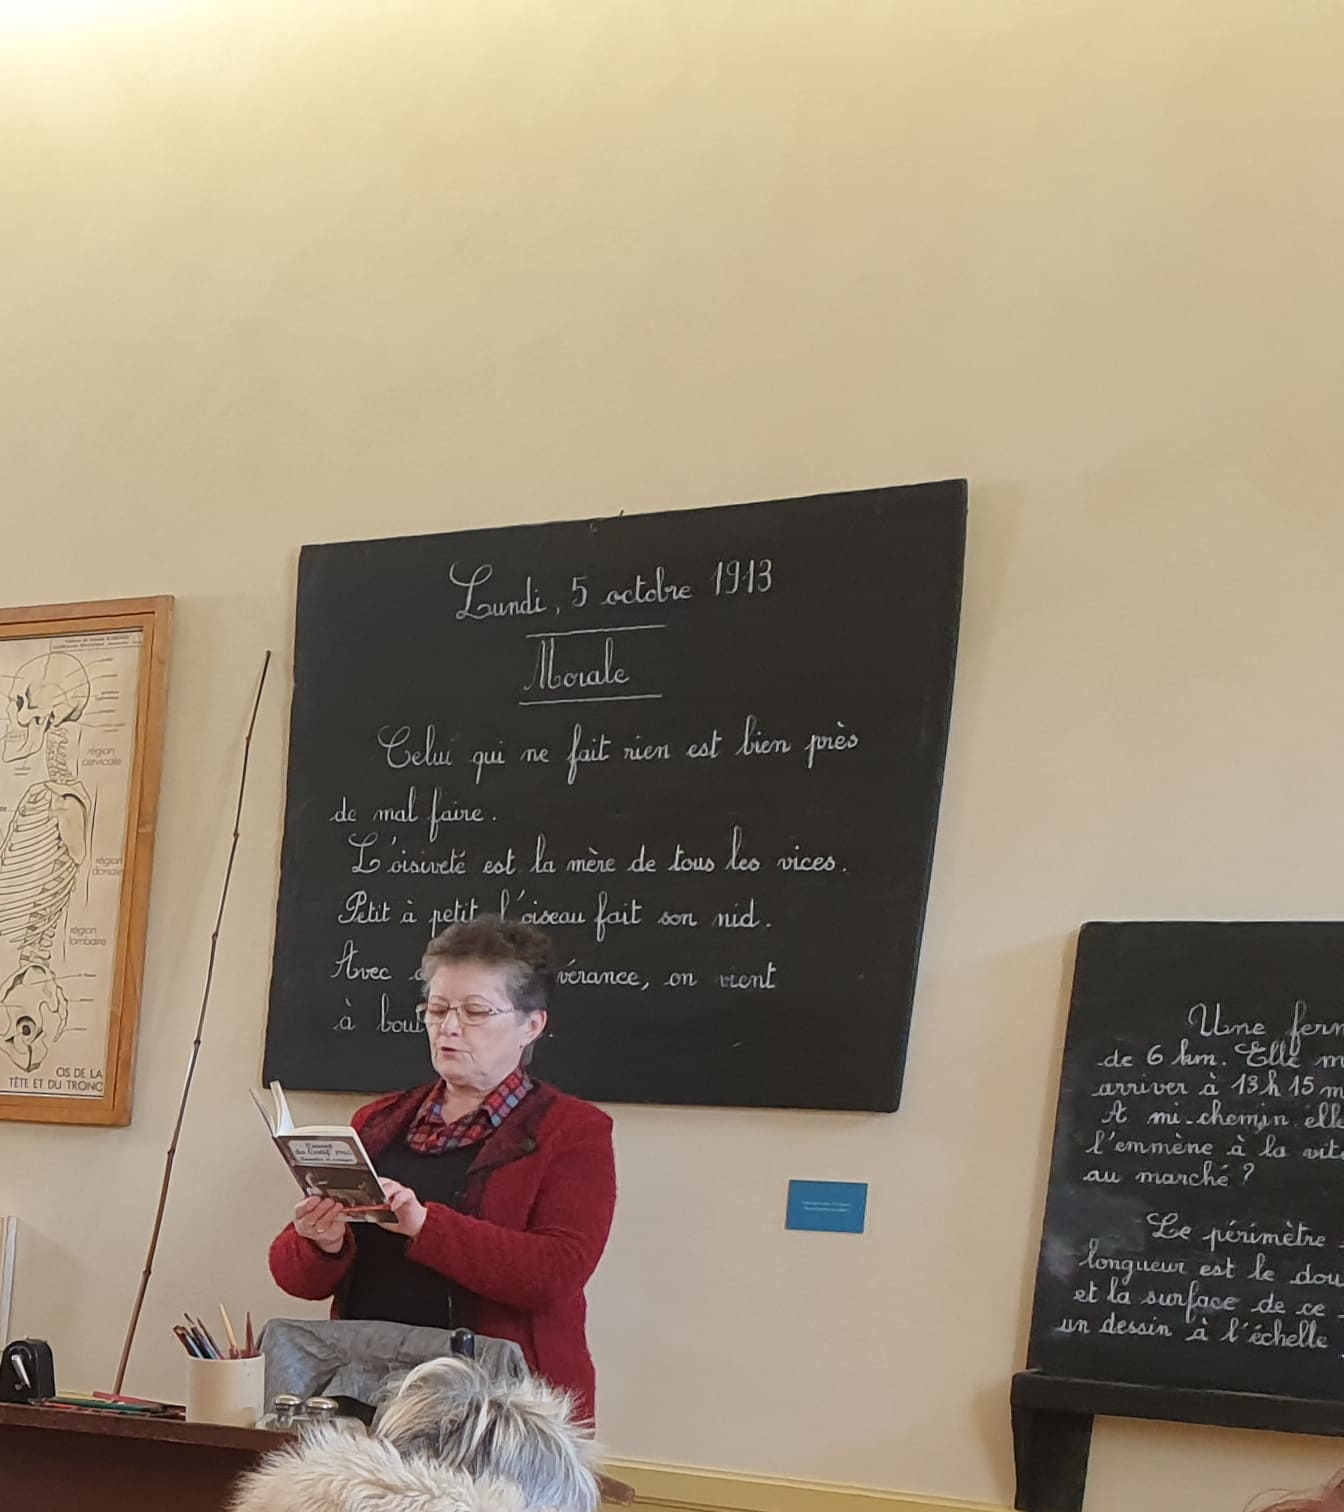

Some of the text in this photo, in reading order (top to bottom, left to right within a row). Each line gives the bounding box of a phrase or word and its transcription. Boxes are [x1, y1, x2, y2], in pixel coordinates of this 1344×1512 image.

[572, 576, 588, 607] 5
[601, 566, 693, 605] octobre
[710, 559, 773, 595] 1913
[523, 637, 630, 691] Morale
[377, 714, 858, 785] Celui qui ne fait rien est bien près
[329, 797, 357, 822] de
[373, 786, 419, 822] mal
[348, 832, 467, 873] L'oisiveté
[482, 848, 516, 874] est
[529, 833, 556, 874] la
[566, 846, 616, 873] mère
[626, 844, 657, 872] de
[668, 844, 715, 872] tous
[725, 825, 761, 872] les
[337, 890, 391, 925] Petit
[399, 900, 417, 925] à
[428, 898, 480, 938] petit
[500, 888, 586, 925] l'oiseau
[594, 891, 642, 942] fait
[657, 911, 698, 926] son
[330, 939, 393, 981] Avec
[557, 959, 776, 990] vérance, on vient
[333, 998, 356, 1032] à
[1187, 1003, 1266, 1037] Une
[1097, 1049, 1134, 1068] de
[1147, 1044, 1163, 1066] 6
[1234, 1040, 1302, 1069] Elle
[33, 1078, 44, 1089] ET
[48, 1079, 62, 1090] DU
[66, 1080, 104, 1092] TRONC
[56, 1067, 103, 1079] OS DE LA
[1091, 1073, 1189, 1097] arriver
[1198, 1072, 1220, 1095] à
[1085, 1130, 1344, 1160] l'emmène à la vit
[1083, 1169, 1121, 1184] au
[1135, 1160, 1231, 1187] marché
[1146, 1213, 1326, 1252] Le périmètre
[1079, 1238, 1188, 1285] longueur
[1200, 1257, 1235, 1279] est
[1247, 1254, 1275, 1282] le
[1074, 1276, 1326, 1324] et la surface de ce
[1059, 1312, 1328, 1349] un dessin à l'échelle
